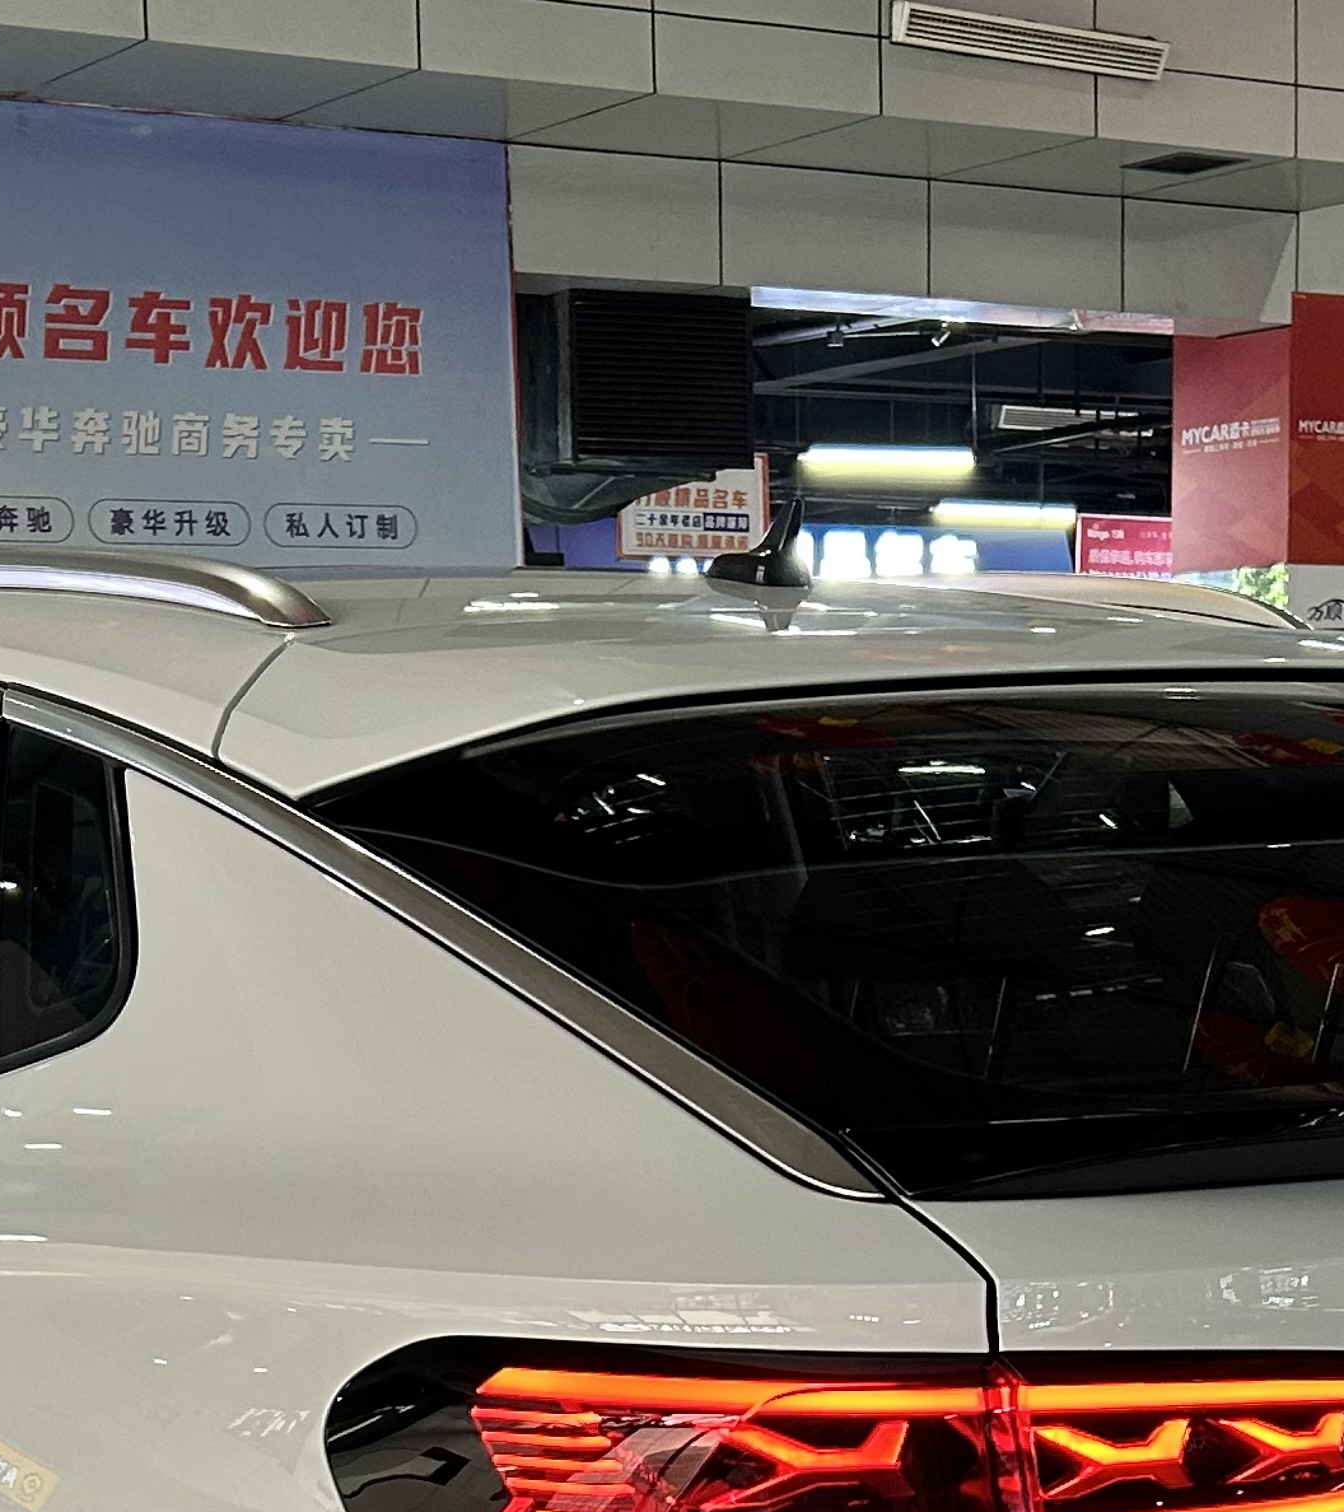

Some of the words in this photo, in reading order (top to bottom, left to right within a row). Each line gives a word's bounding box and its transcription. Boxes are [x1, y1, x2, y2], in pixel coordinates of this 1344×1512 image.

[1181, 424, 1228, 446] MYCAR
[109, 507, 232, 538] 豪华升级
[285, 512, 399, 541] 私人订制
